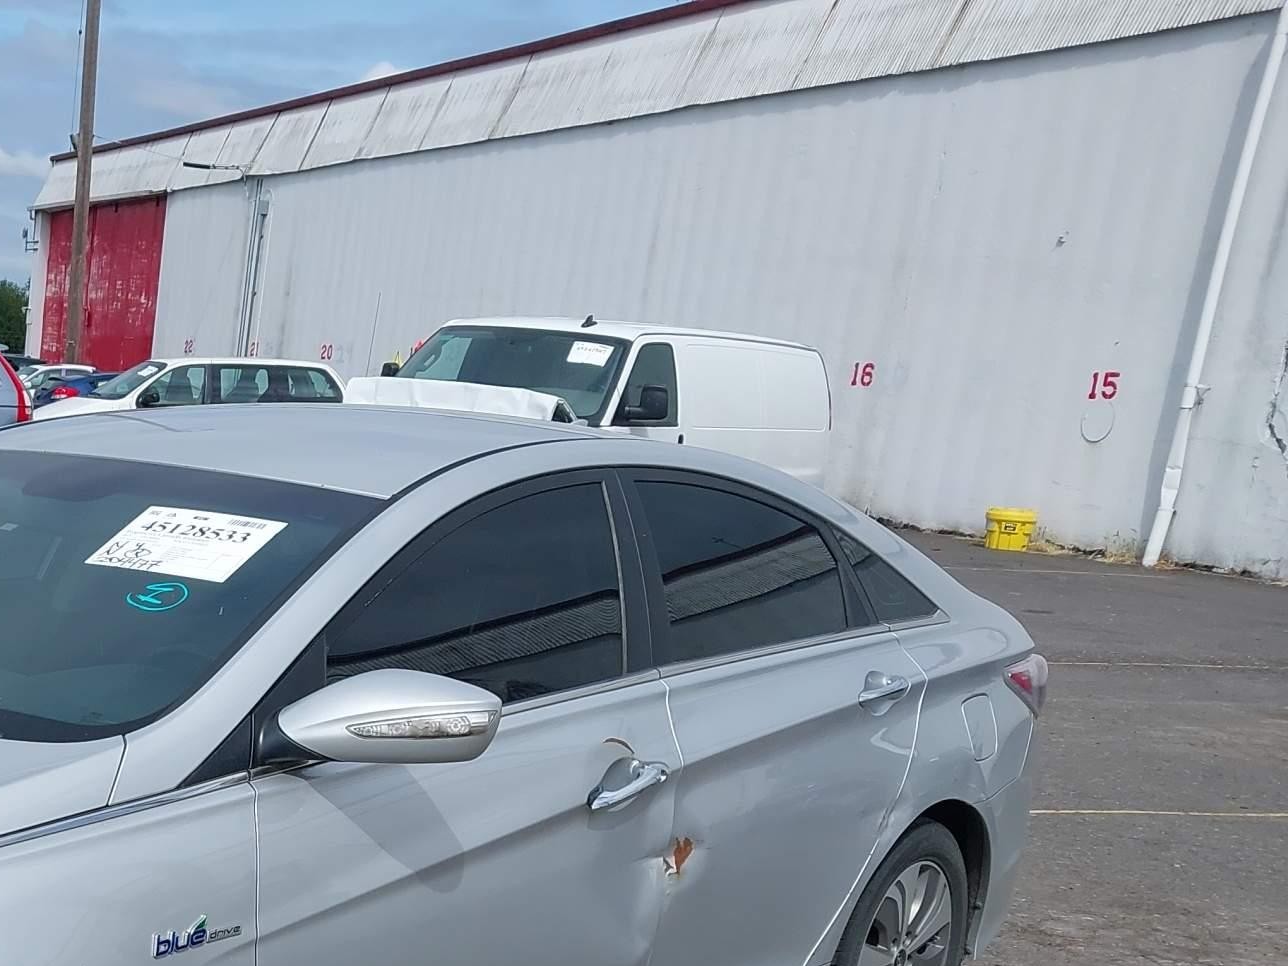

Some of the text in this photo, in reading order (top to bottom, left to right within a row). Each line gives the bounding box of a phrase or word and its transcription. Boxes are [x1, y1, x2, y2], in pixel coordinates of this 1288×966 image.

[184, 339, 193, 353] 22
[250, 341, 259, 357] 21
[321, 344, 333, 360] 20
[851, 362, 875, 386] 16
[1088, 371, 1121, 400] 15
[141, 520, 251, 543] 45128533
[152, 925, 241, 959] blue drive
